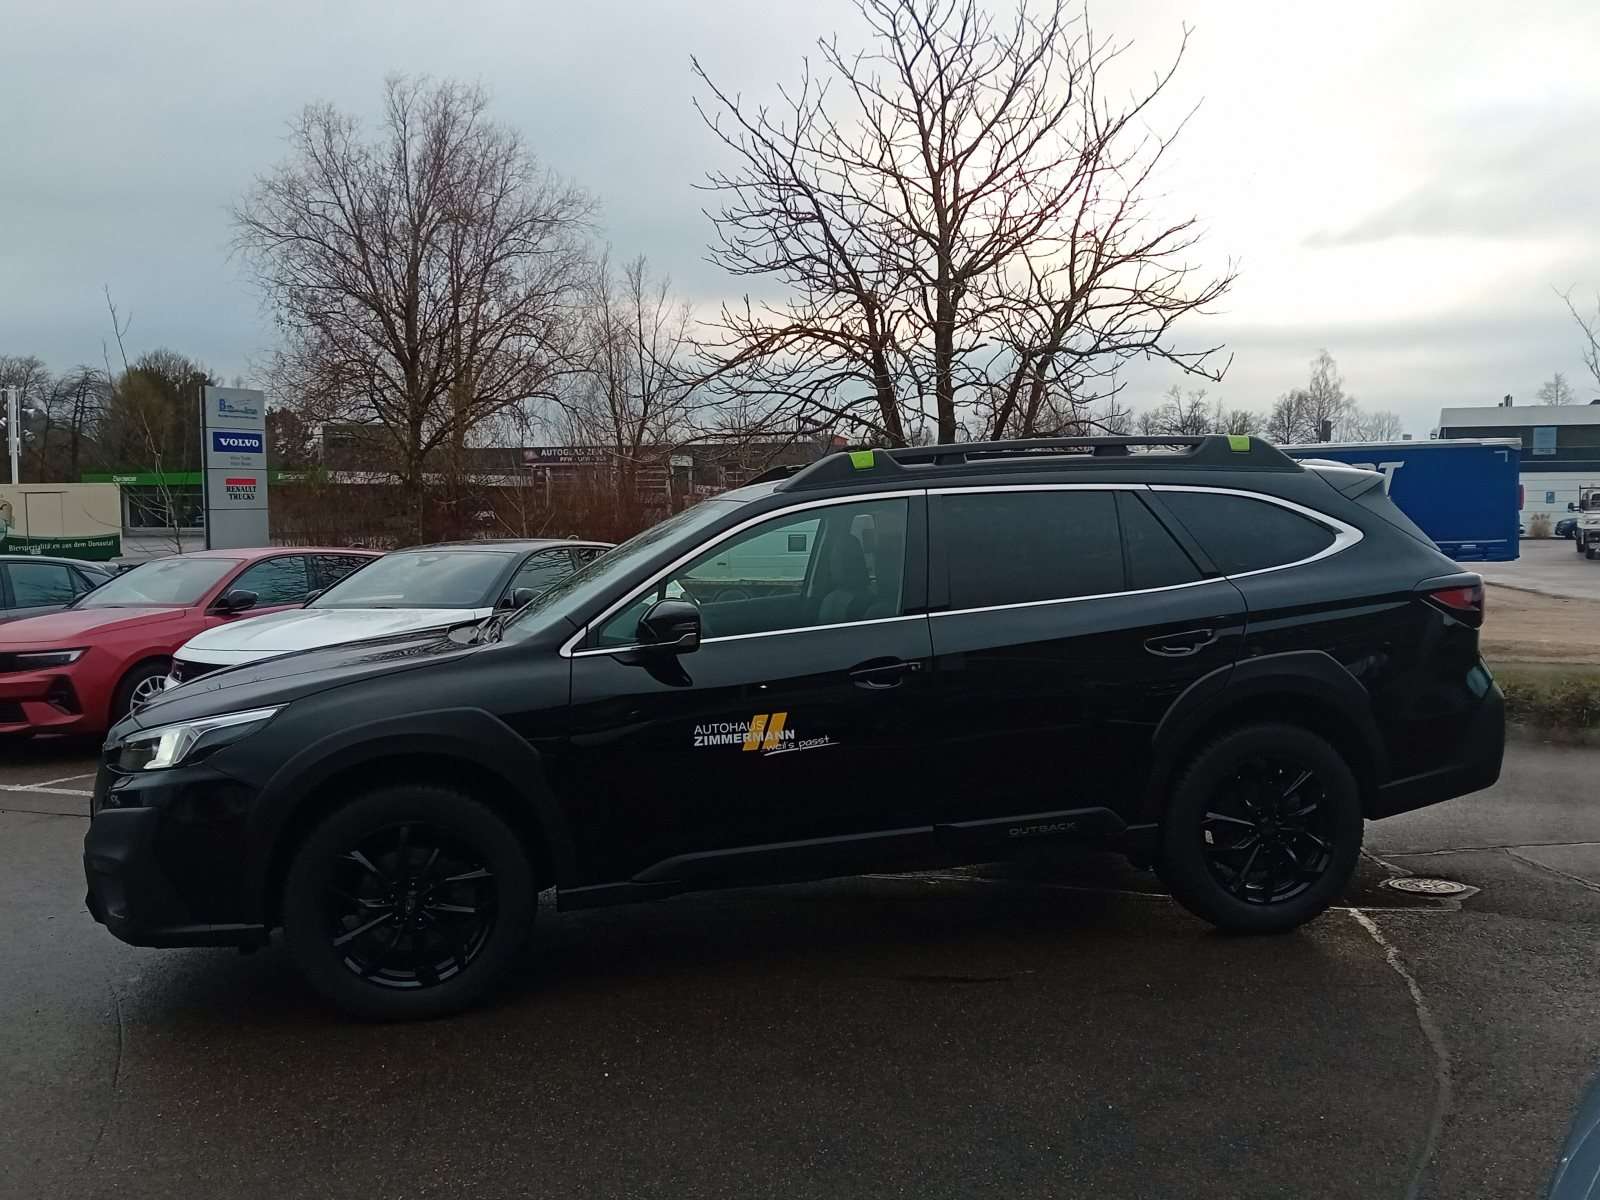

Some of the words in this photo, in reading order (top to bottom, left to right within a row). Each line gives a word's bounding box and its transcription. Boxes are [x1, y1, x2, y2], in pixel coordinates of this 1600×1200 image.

[219, 438, 259, 448] VOLVO
[226, 485, 257, 493] RENAULT
[693, 720, 765, 735] AUTOHAUS
[693, 729, 795, 747] ZIMMERMANN
[799, 734, 831, 752] passt
[1008, 822, 1075, 836] OUTBACK
